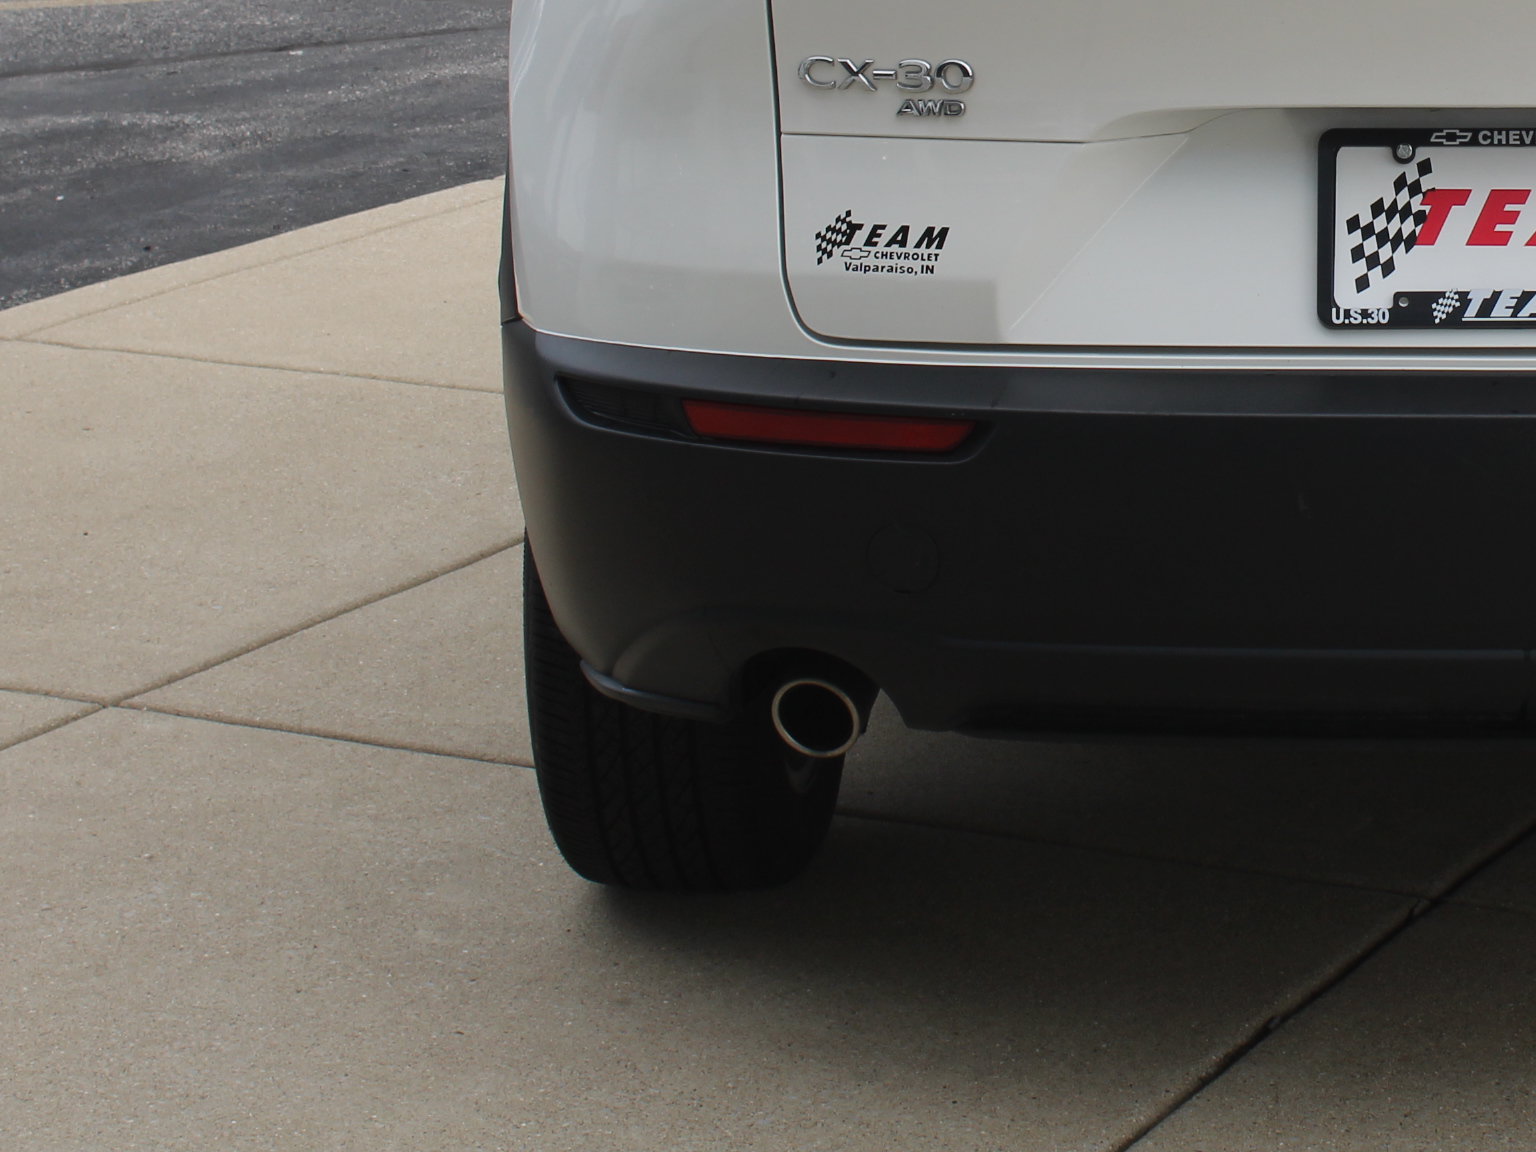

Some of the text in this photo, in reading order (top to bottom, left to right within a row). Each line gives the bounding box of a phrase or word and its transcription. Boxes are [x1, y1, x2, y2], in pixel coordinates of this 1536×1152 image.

[798, 55, 976, 95] CX-30
[896, 99, 967, 117] AWD
[842, 223, 950, 250] TEAM
[873, 250, 940, 262] CHEVROLET
[844, 261, 935, 276] Valparaiso, IN
[1331, 307, 1391, 325] U.S.30
